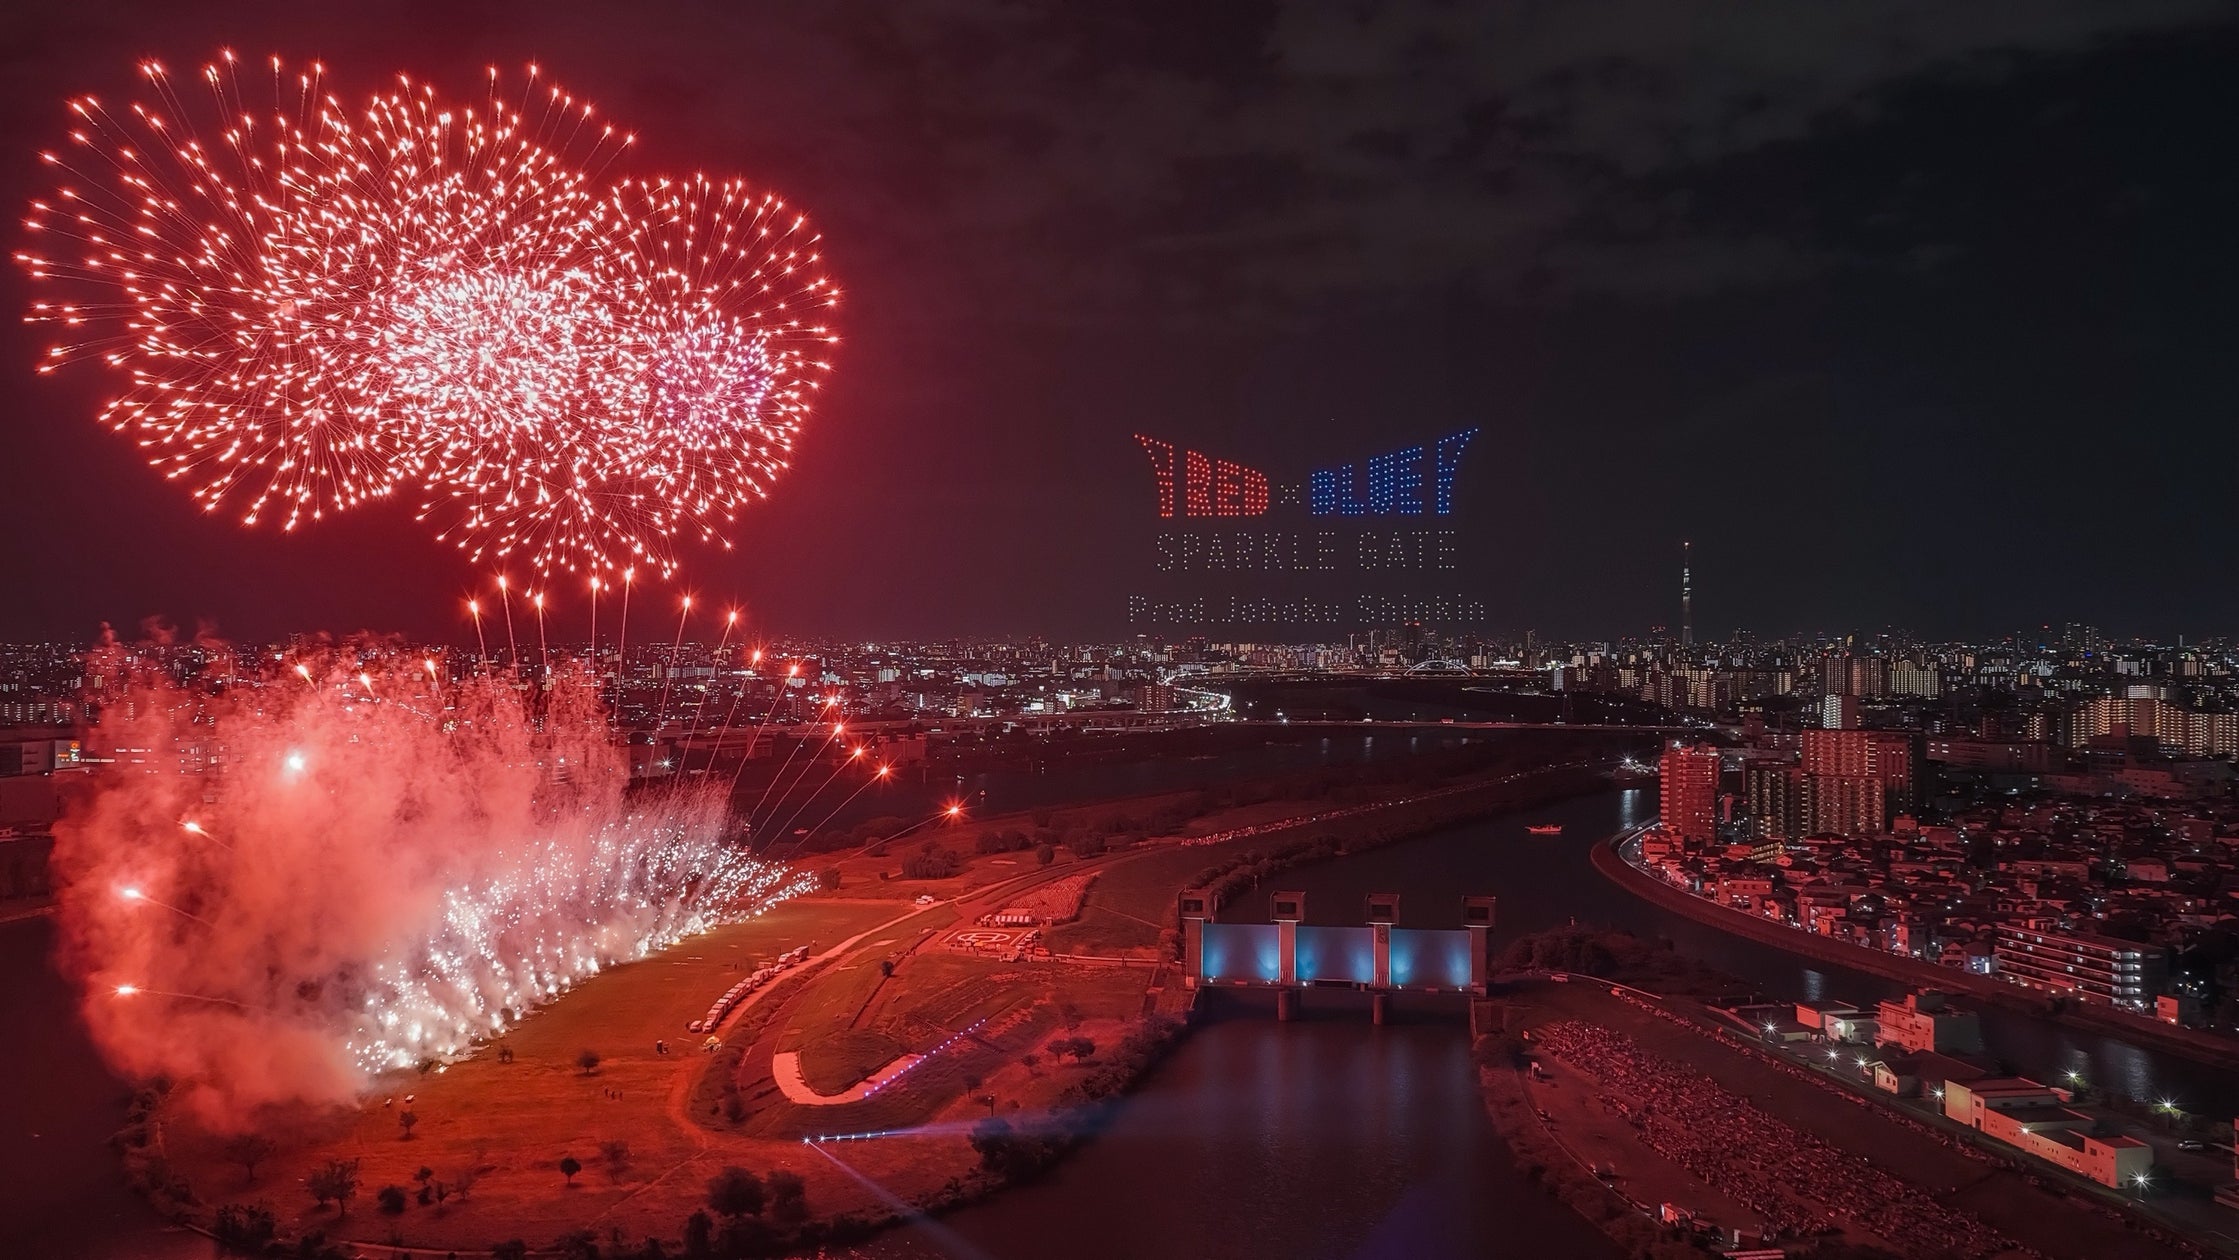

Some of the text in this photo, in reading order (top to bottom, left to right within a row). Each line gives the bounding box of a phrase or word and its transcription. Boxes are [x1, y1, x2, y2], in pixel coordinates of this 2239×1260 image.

[1187, 450, 1269, 517] RED
[1311, 446, 1423, 516] BLUE
[1156, 530, 1455, 571] SPARKLE GATE
[1357, 593, 1484, 623] Shinkin
